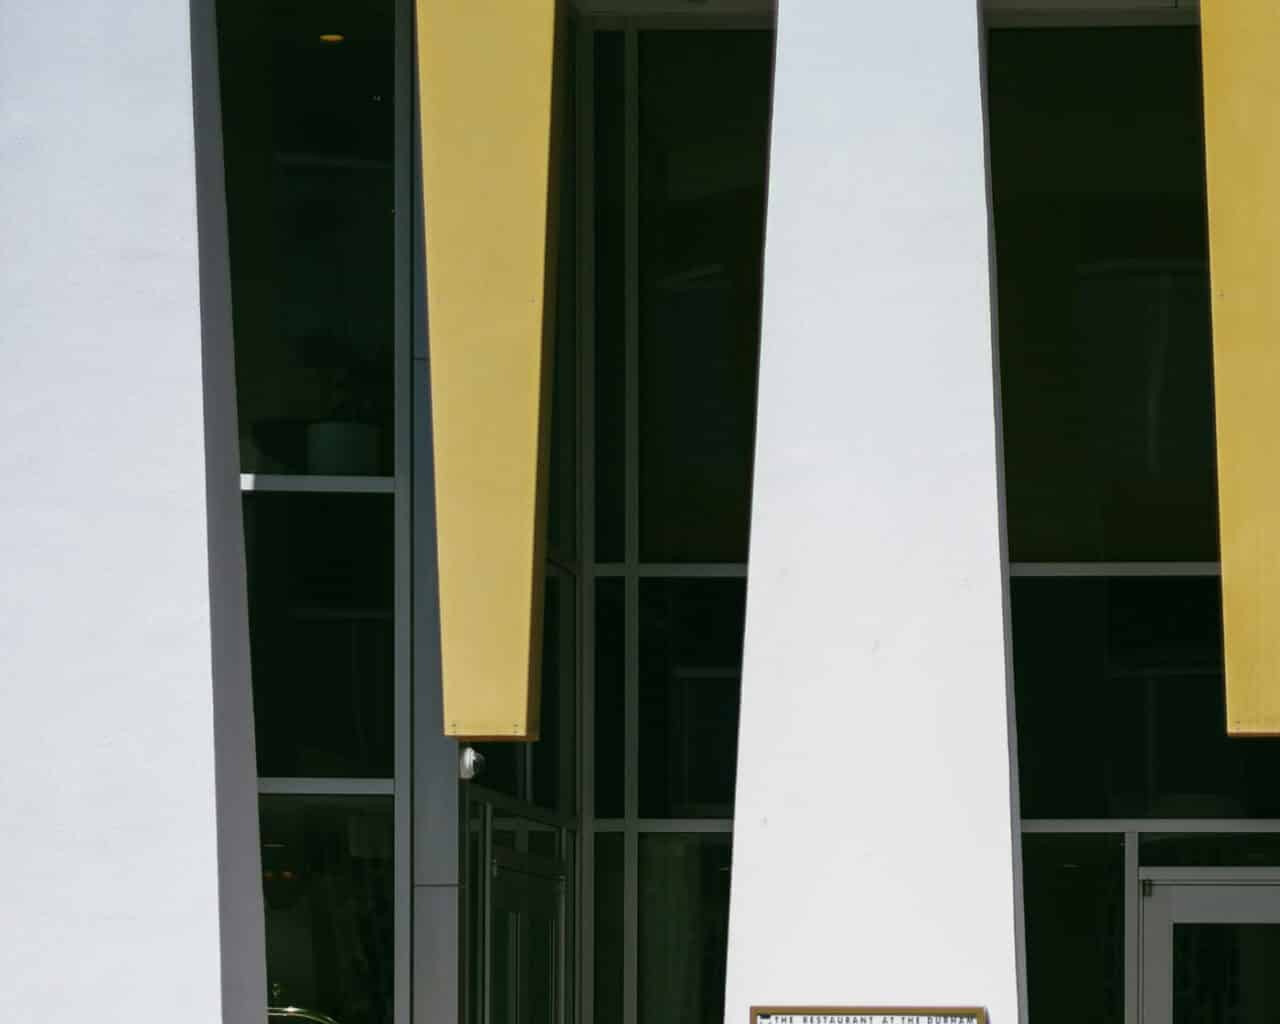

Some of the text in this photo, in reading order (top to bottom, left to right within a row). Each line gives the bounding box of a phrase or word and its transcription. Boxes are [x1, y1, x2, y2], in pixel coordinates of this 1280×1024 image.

[774, 1016, 976, 1024] THE RESTAURANT AT THE DURHAM
